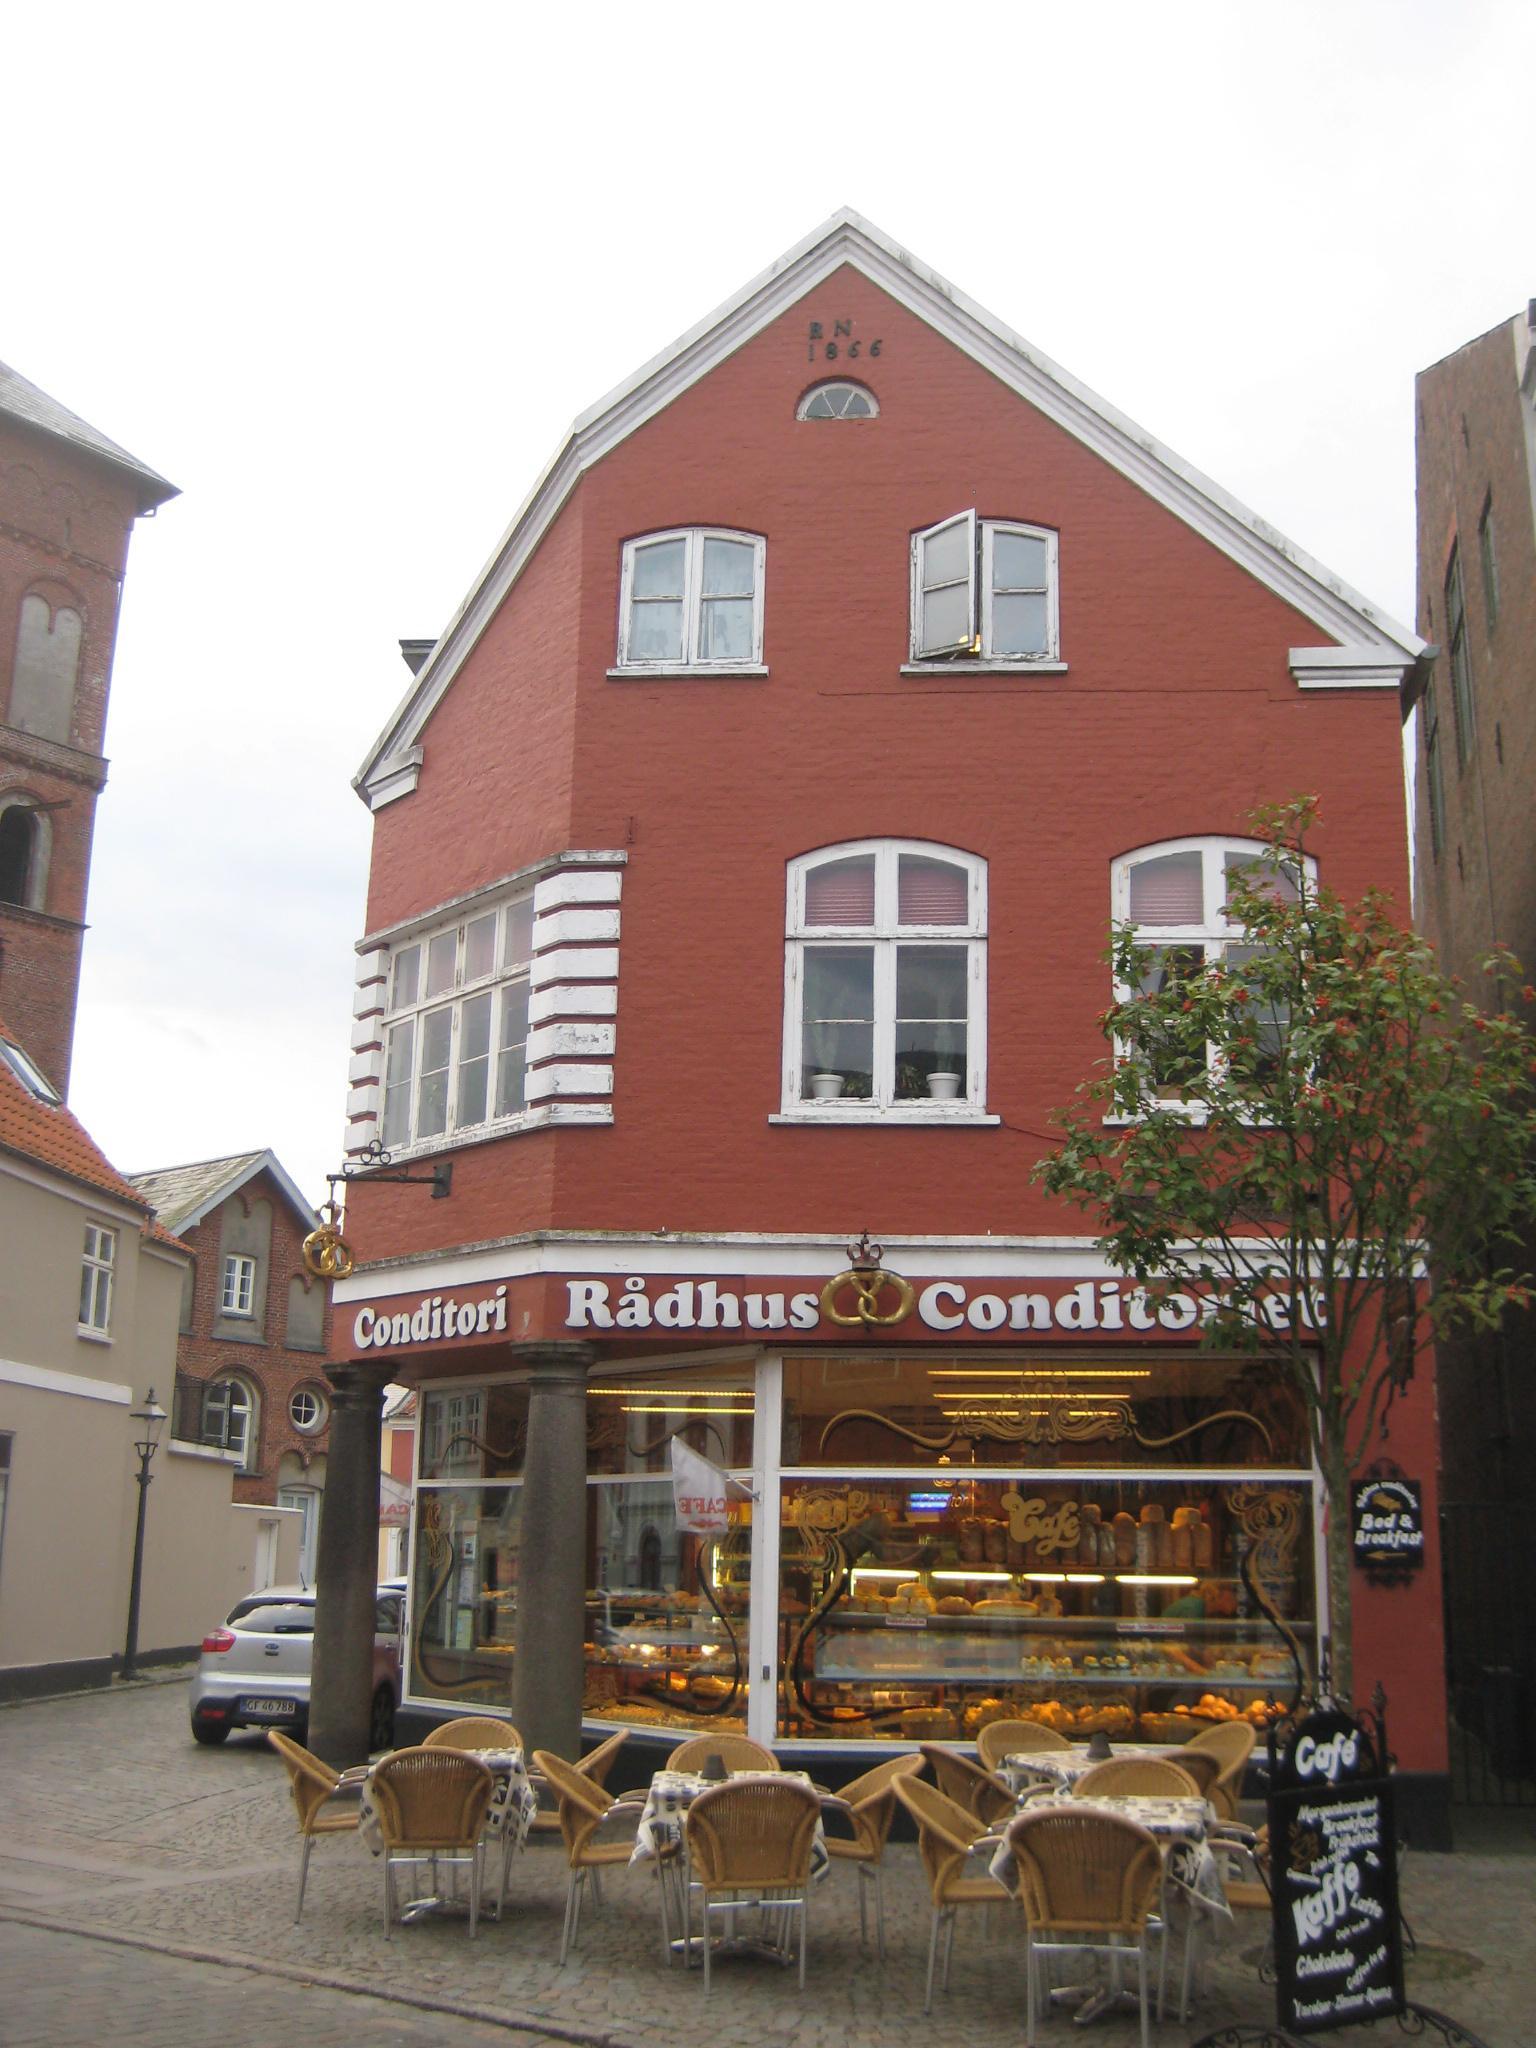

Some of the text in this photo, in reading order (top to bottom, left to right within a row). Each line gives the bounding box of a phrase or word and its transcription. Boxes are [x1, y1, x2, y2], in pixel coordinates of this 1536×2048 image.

[808, 338, 883, 362] 1866
[353, 1285, 508, 1349] Conditori
[565, 1277, 1329, 1331] Rådhus Conditoret
[1354, 1529, 1424, 1550] Breakfast
[1360, 1513, 1415, 1530] Bed &
[1295, 1728, 1359, 1779] Café
[1292, 1861, 1360, 1946] Kaffe
